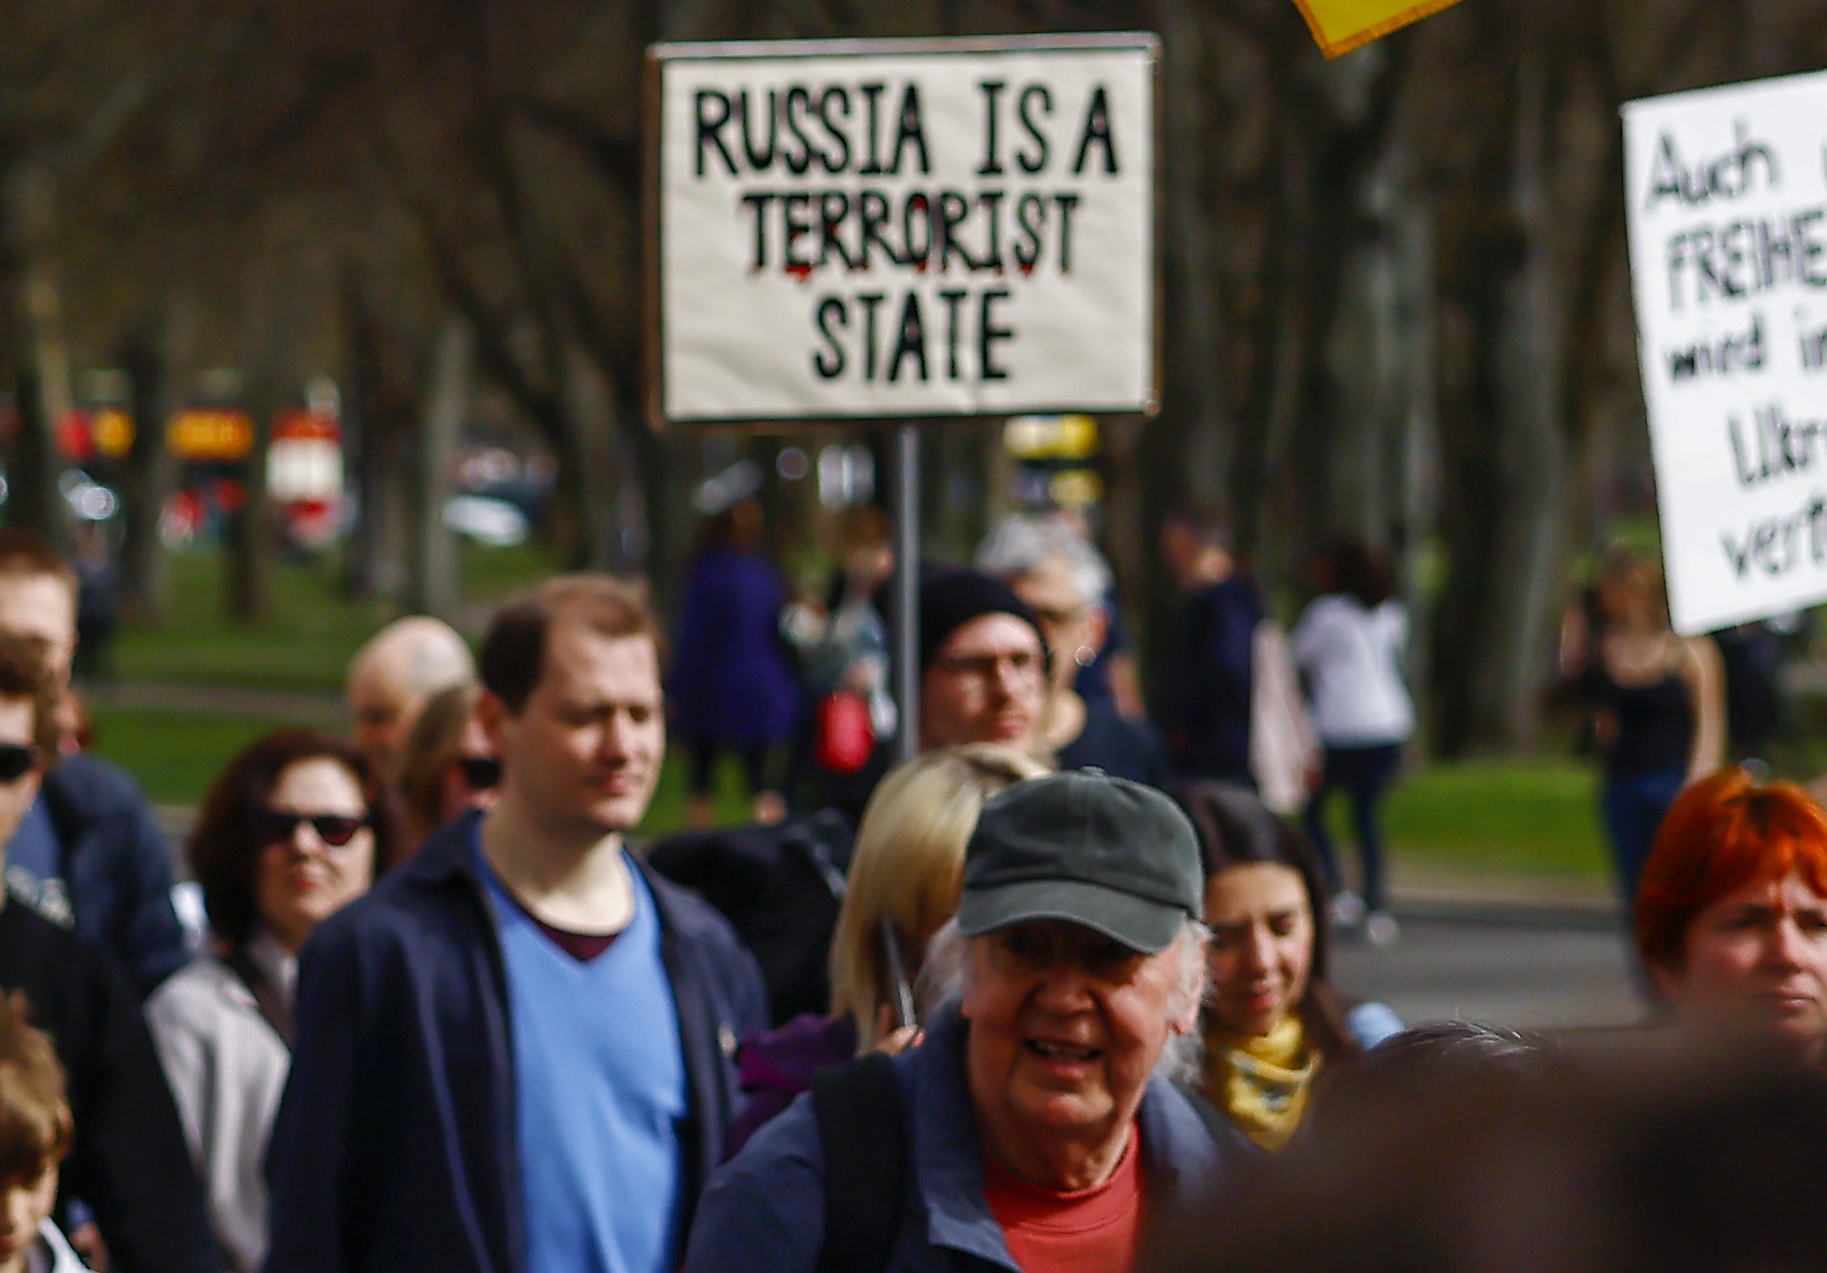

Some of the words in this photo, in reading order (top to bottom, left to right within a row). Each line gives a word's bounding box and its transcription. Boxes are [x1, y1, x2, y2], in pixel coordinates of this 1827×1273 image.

[693, 82, 933, 179] RUSSIA
[975, 80, 1055, 177] IS
[1072, 84, 1120, 176] A
[1646, 120, 1782, 209] Auch
[742, 190, 1082, 277] TERRORIST
[814, 290, 1014, 383] STATE
[1664, 317, 1765, 384] wird
